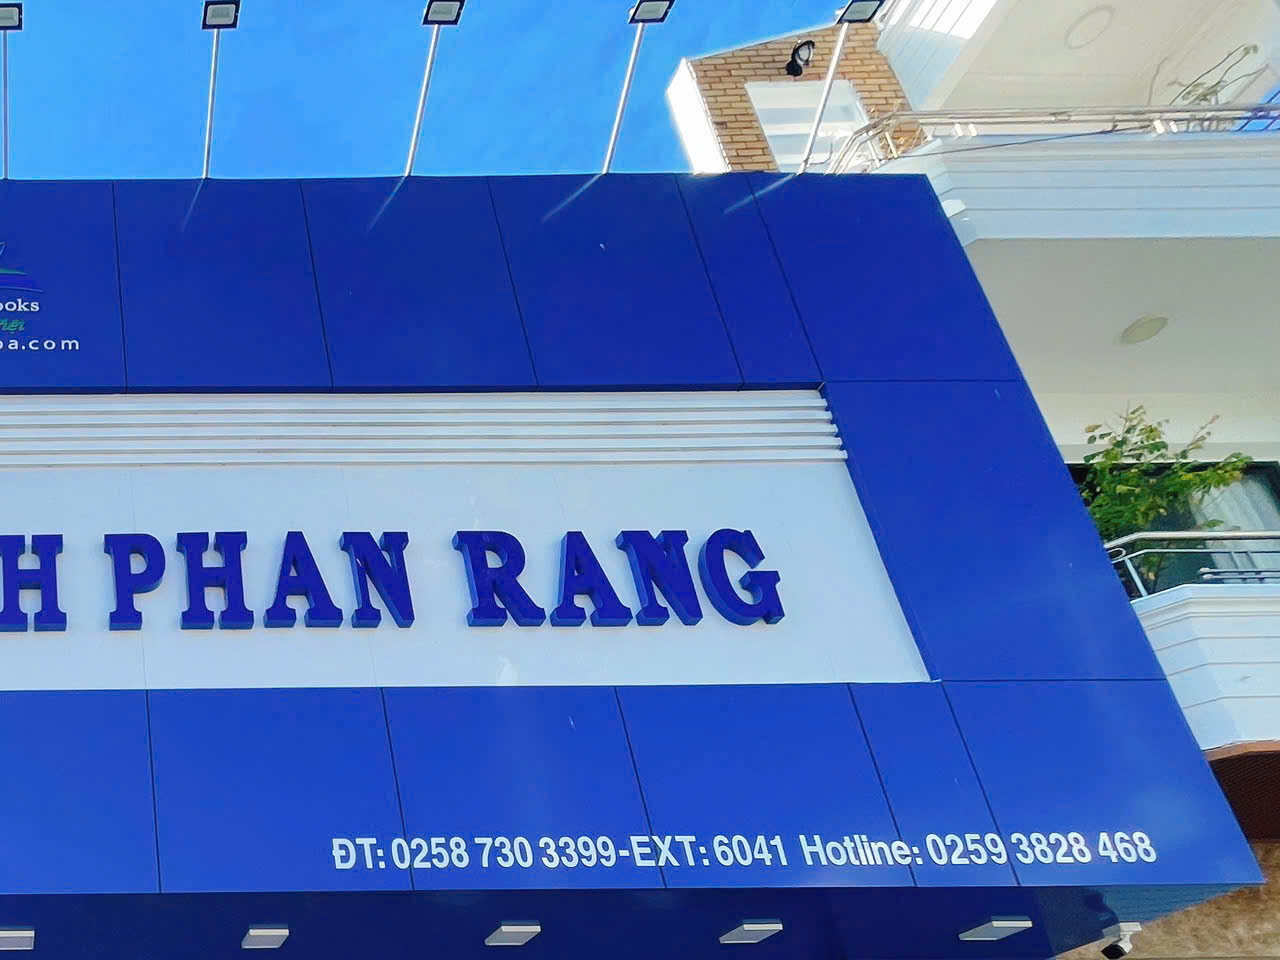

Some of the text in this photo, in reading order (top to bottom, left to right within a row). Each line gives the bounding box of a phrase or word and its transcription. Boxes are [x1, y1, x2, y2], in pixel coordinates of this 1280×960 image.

[103, 530, 416, 631] PHAN
[452, 528, 786, 628] RANG
[331, 831, 1158, 870] ĐT: 0258 730 3399-EXT: 6041 Hotline: 0259 3828 468
